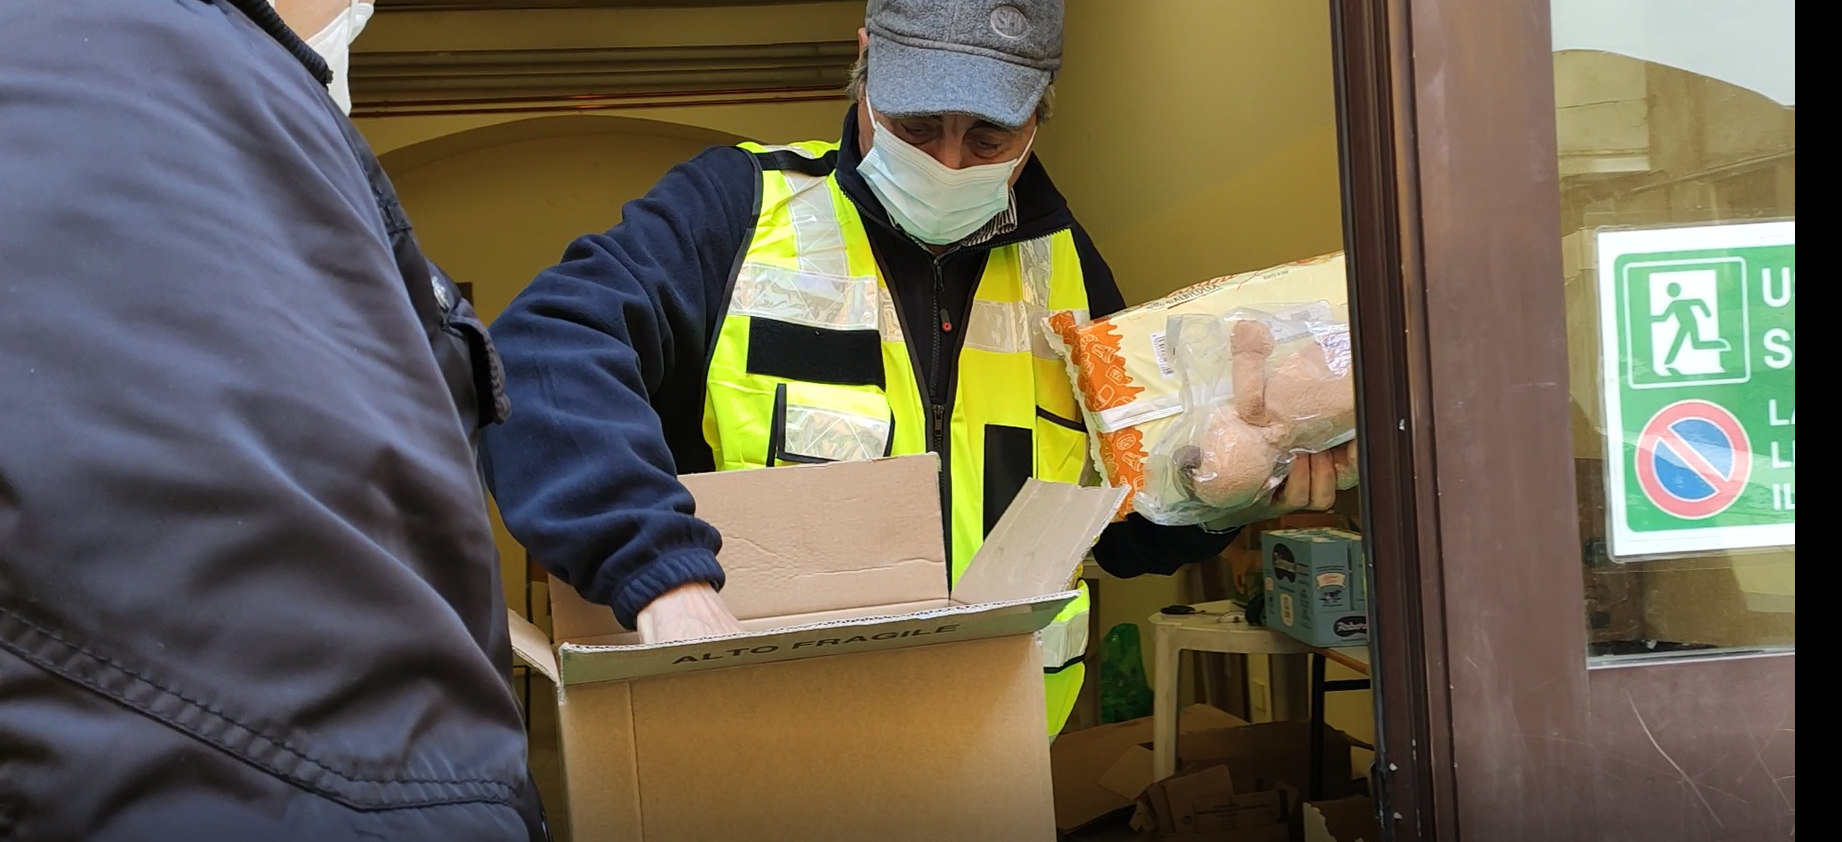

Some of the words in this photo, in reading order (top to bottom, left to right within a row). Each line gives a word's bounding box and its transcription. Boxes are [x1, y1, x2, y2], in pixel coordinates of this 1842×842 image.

[1761, 266, 1795, 308] U
[672, 645, 779, 665] ALTO
[791, 623, 961, 651] FRAGILE
